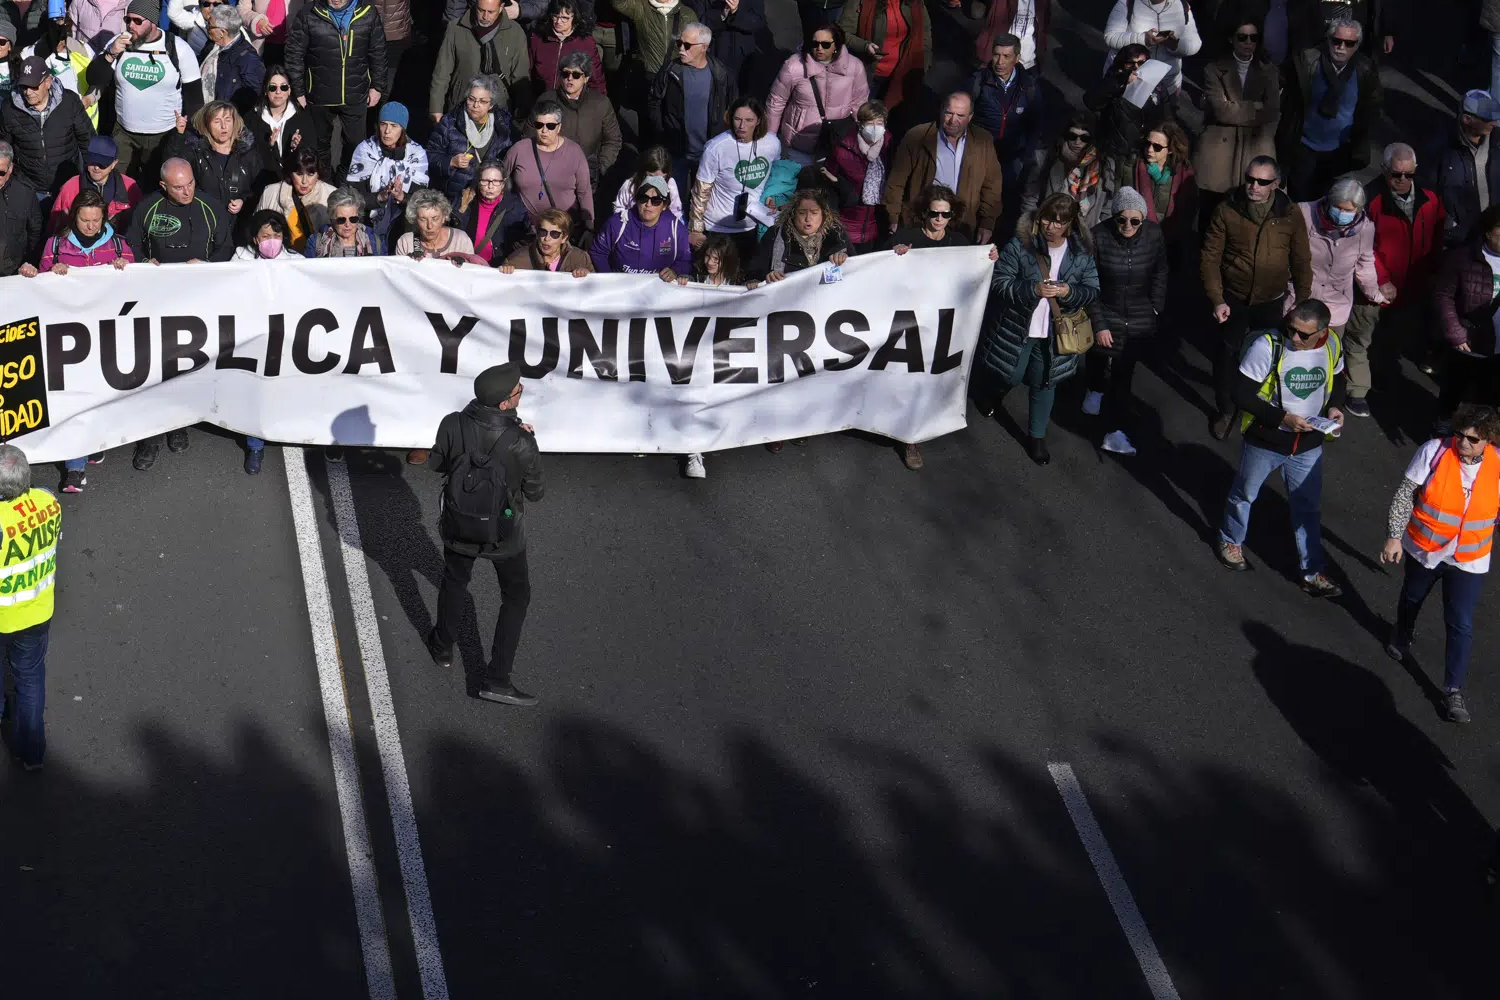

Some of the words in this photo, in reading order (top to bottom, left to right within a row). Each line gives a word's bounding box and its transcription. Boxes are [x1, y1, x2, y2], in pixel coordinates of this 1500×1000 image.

[124, 70, 159, 82] PÚBLICA
[125, 63, 160, 74] SANIDAD
[45, 301, 396, 392] PÚBLICA
[424, 311, 481, 375] Y
[507, 307, 965, 386] UNIVERSAL
[1290, 381, 1320, 390] PÚBLICA
[13, 499, 37, 517] TU
[5, 500, 60, 539] DECIDES
